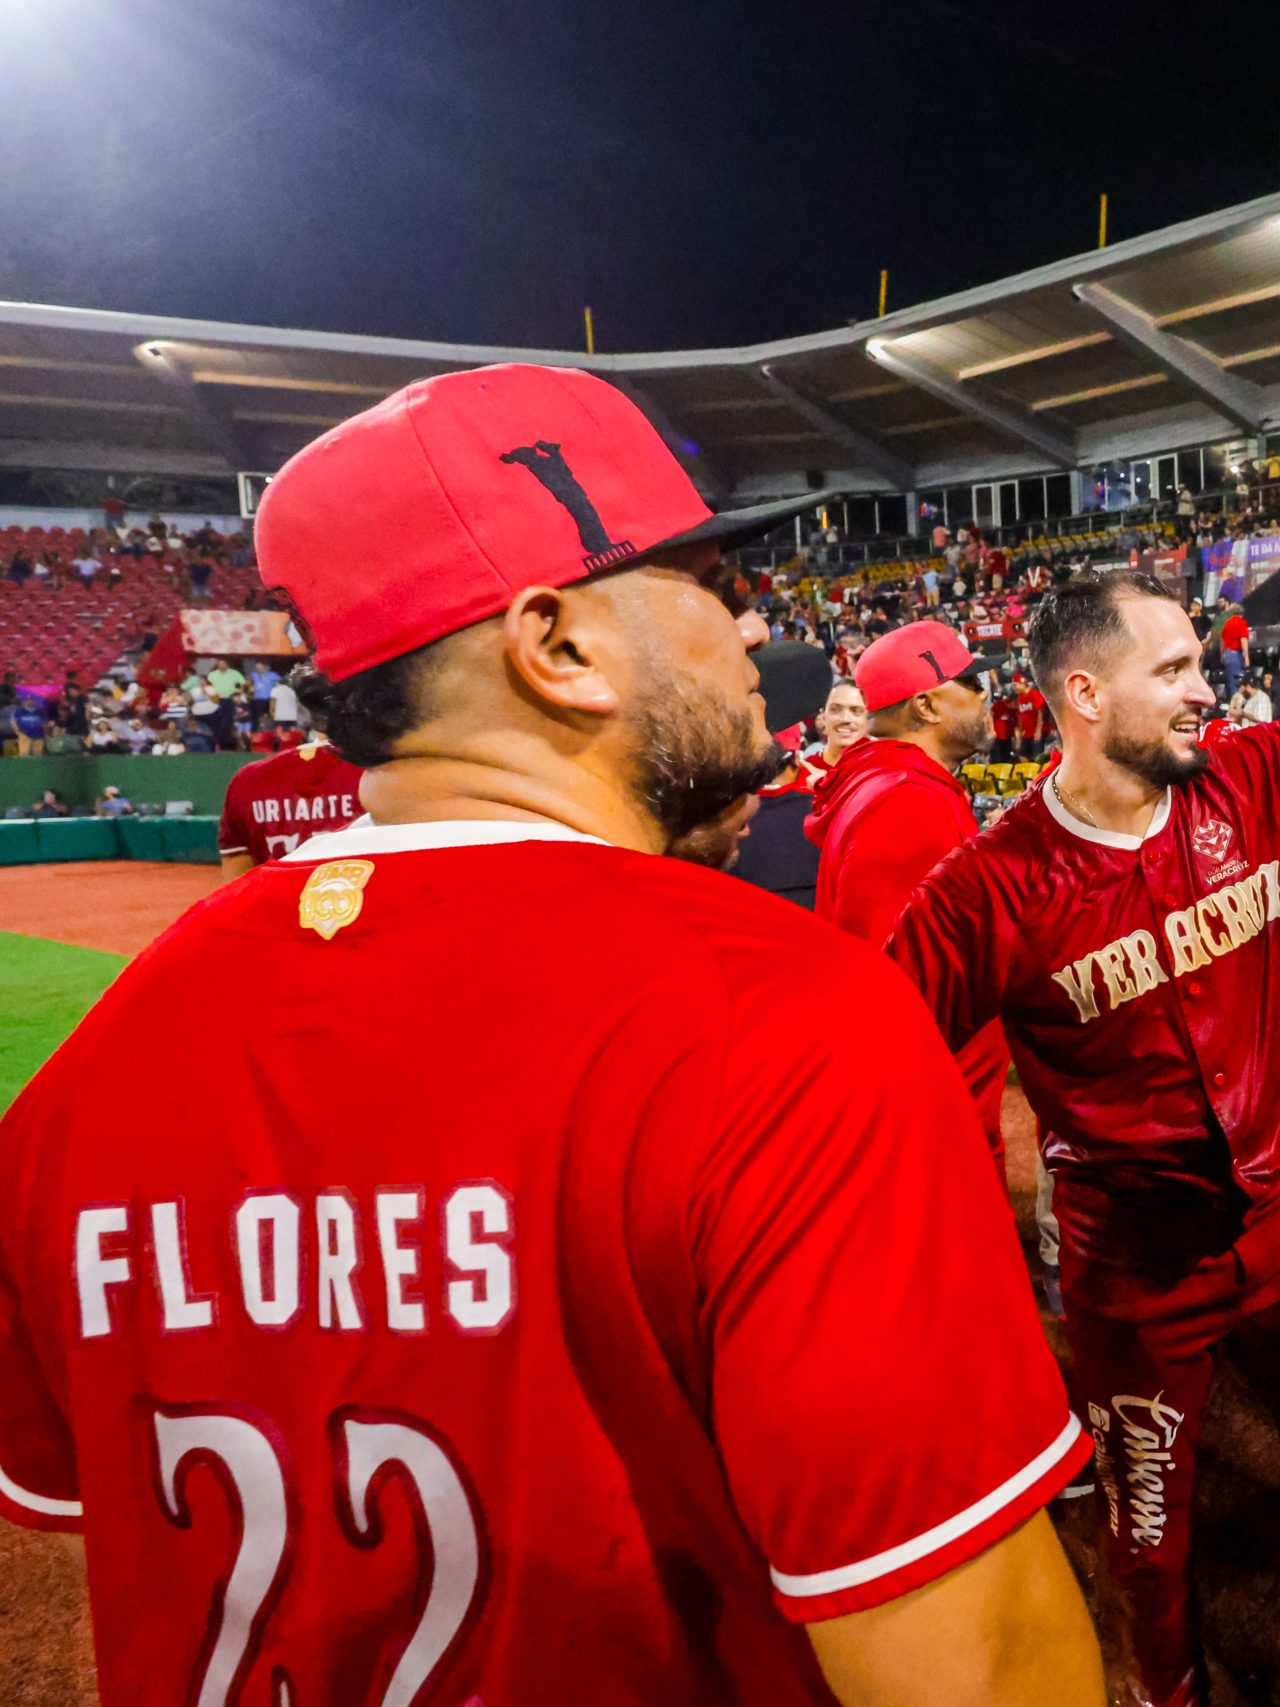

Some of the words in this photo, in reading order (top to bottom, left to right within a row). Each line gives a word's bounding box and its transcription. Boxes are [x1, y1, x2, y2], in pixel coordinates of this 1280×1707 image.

[251, 794, 354, 824] URIARTE
[1206, 861, 1249, 885] VERACRUZ
[76, 1183, 512, 1340] FLORES
[152, 1409, 480, 1707] 22
